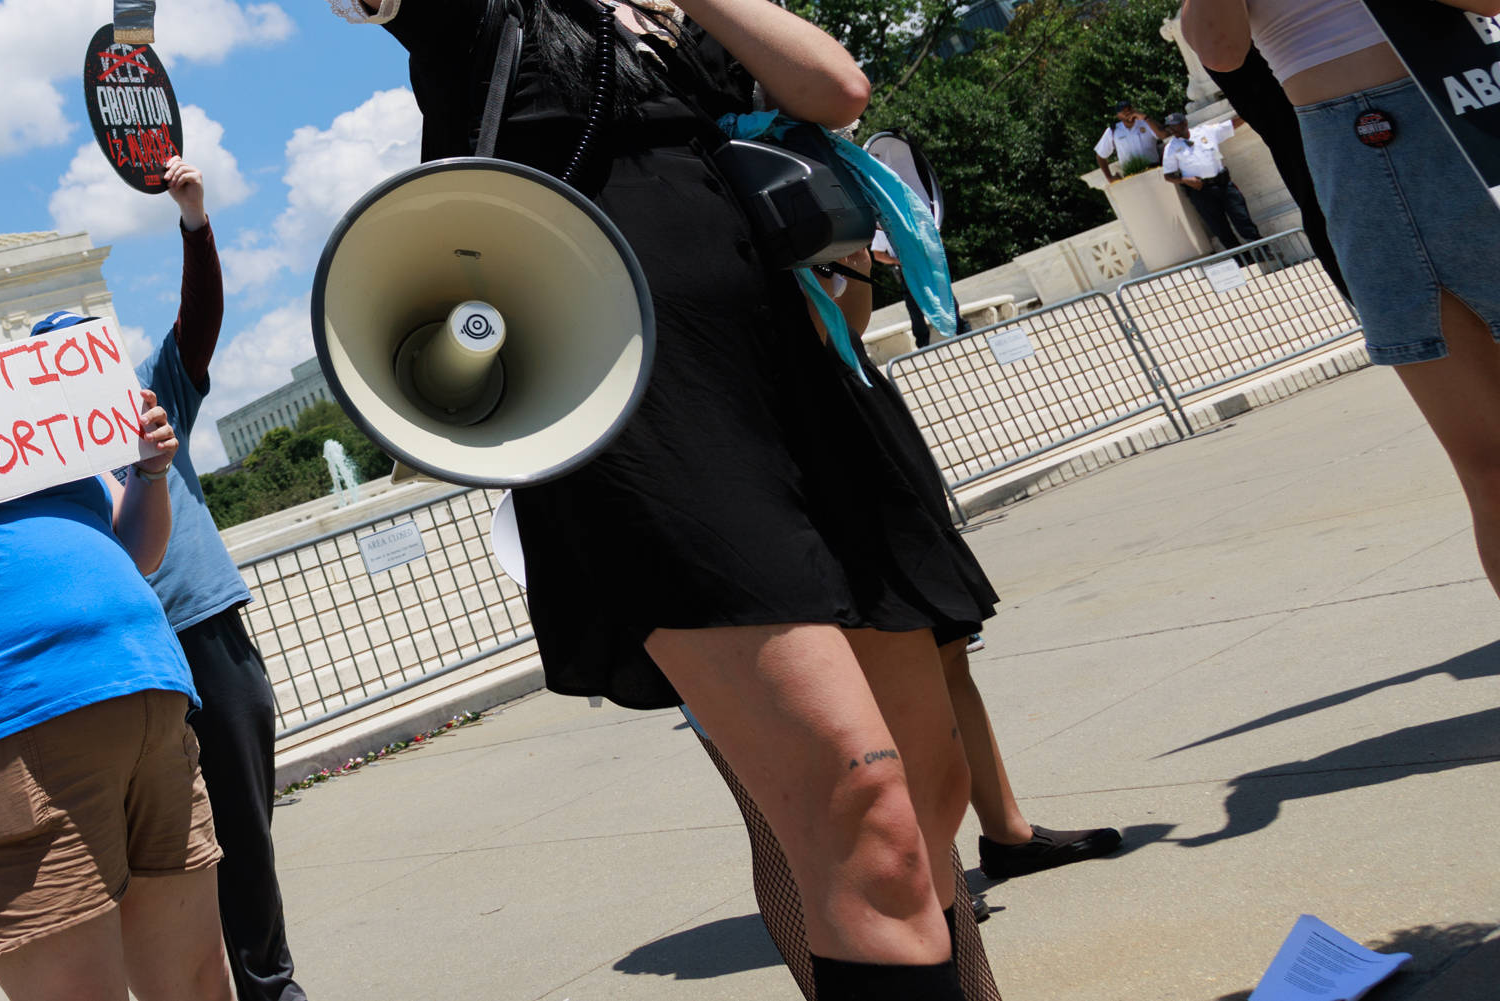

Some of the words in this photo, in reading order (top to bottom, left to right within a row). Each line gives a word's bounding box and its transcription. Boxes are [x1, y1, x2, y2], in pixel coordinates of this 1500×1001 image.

[101, 42, 149, 84] KEEP
[96, 85, 173, 126] ABORTION
[125, 121, 181, 173] MURDER
